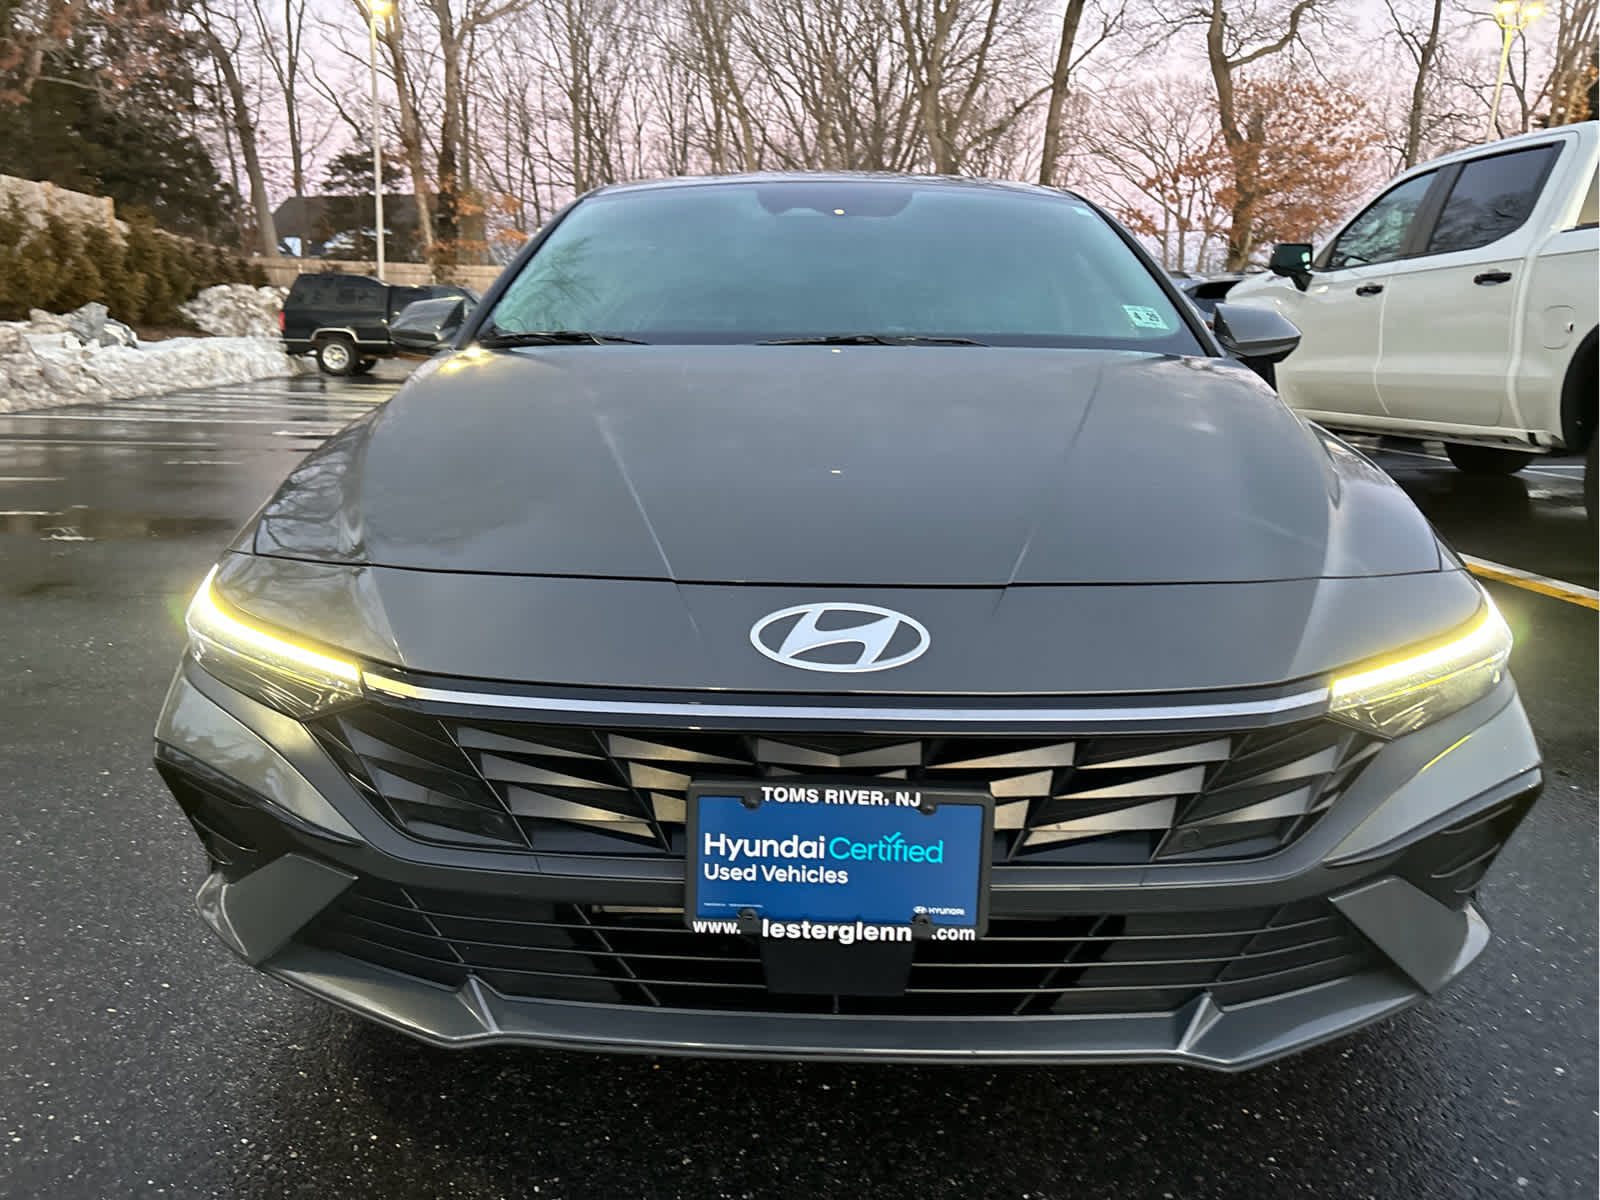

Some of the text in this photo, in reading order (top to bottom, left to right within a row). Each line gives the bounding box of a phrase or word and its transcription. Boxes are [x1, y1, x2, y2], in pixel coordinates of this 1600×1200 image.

[761, 786, 921, 808] TOMS RIVER, NJ
[704, 831, 943, 863] Hyundai Certified
[704, 863, 849, 884] Used Vehicles
[761, 918, 912, 944] lesterglenn
